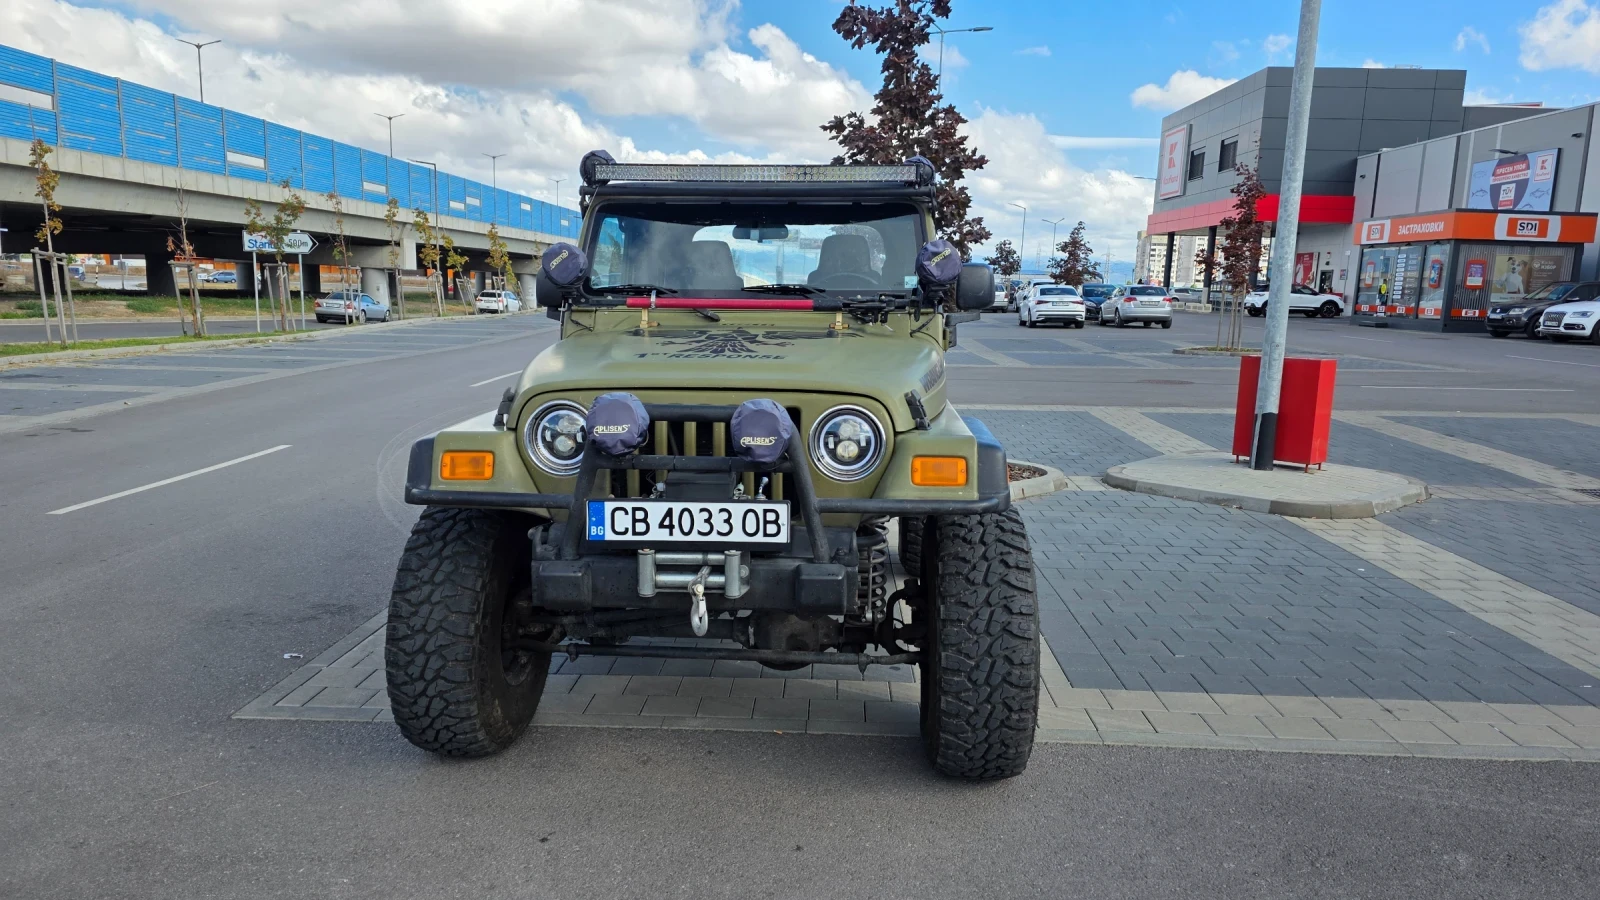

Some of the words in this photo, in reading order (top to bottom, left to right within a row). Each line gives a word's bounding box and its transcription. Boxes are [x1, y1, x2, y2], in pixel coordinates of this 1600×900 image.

[1397, 221, 1445, 235] ЗАСТРАХОВКИ
[1518, 222, 1537, 232] SDI
[594, 424, 629, 436] APLISENS
[740, 436, 776, 447] APLISENS
[611, 506, 650, 536] CB
[658, 507, 733, 537] 4033
[742, 508, 781, 537] OB
[590, 526, 604, 536] BG
